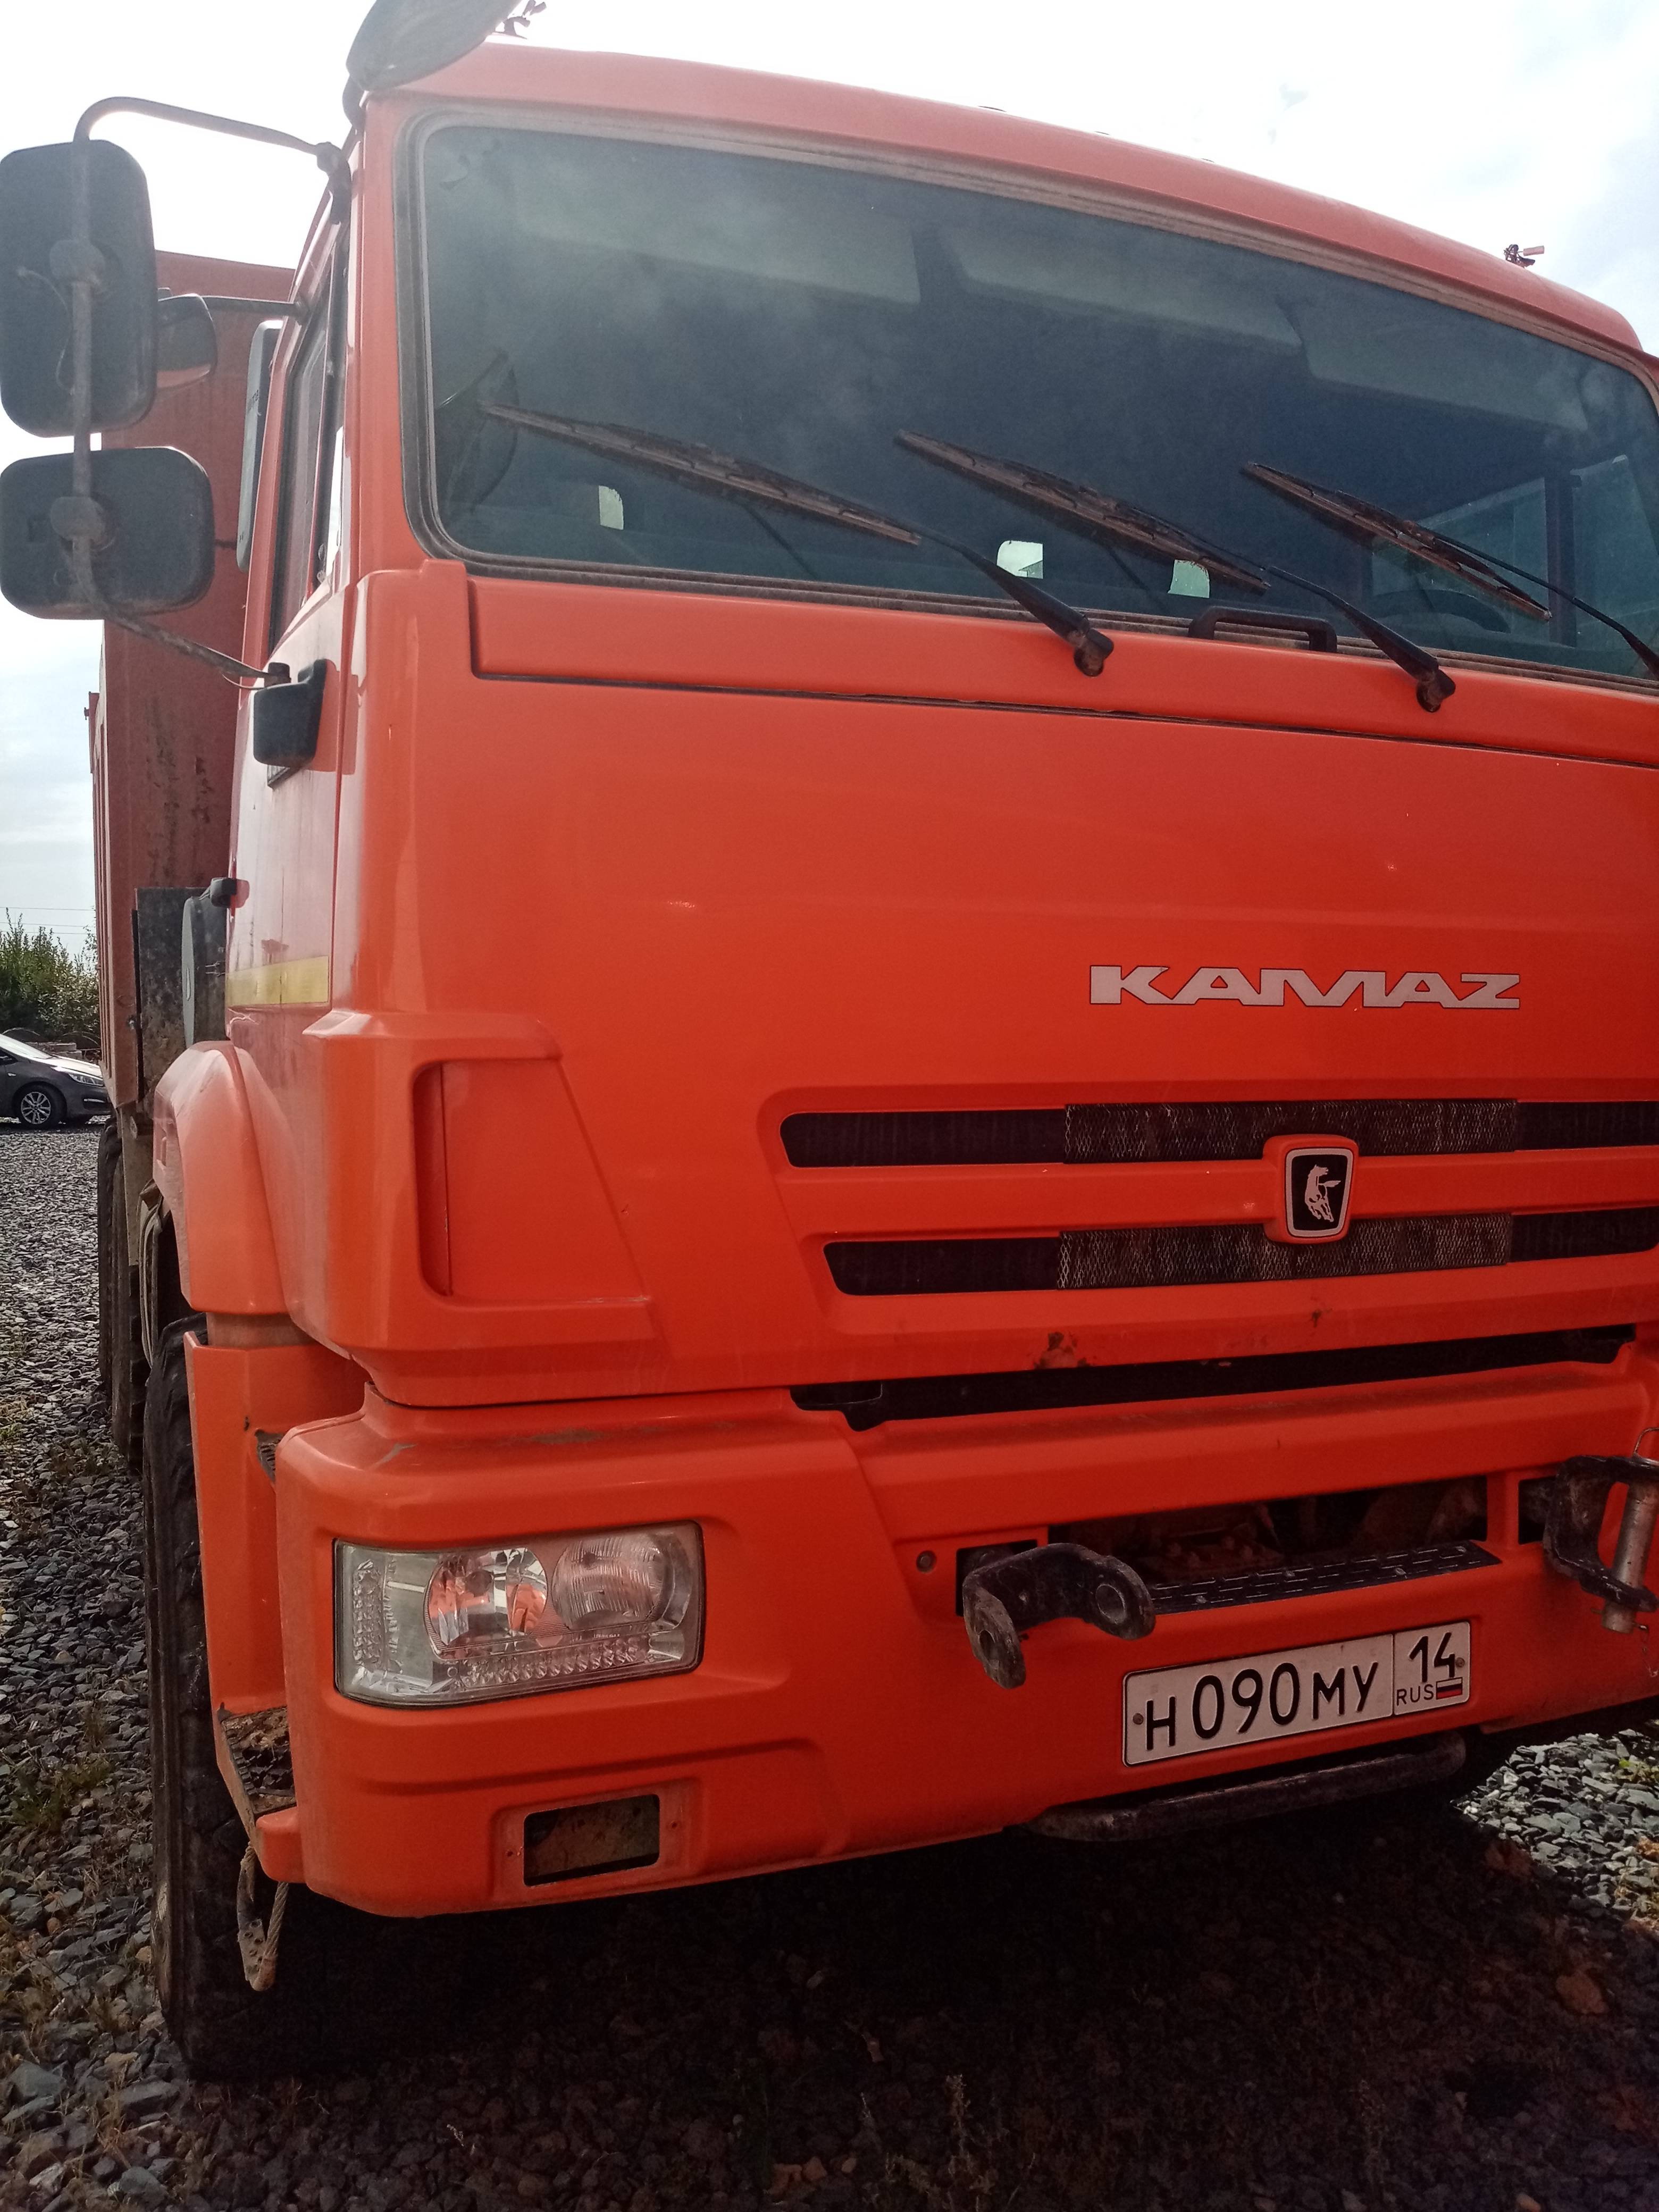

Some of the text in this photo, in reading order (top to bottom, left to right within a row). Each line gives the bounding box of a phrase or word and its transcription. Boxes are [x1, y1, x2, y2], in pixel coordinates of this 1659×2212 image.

[1090, 966, 1520, 1009] KAMAZ
[1409, 1632, 1456, 1682] 14
[1396, 1683, 1434, 1706] RUS
